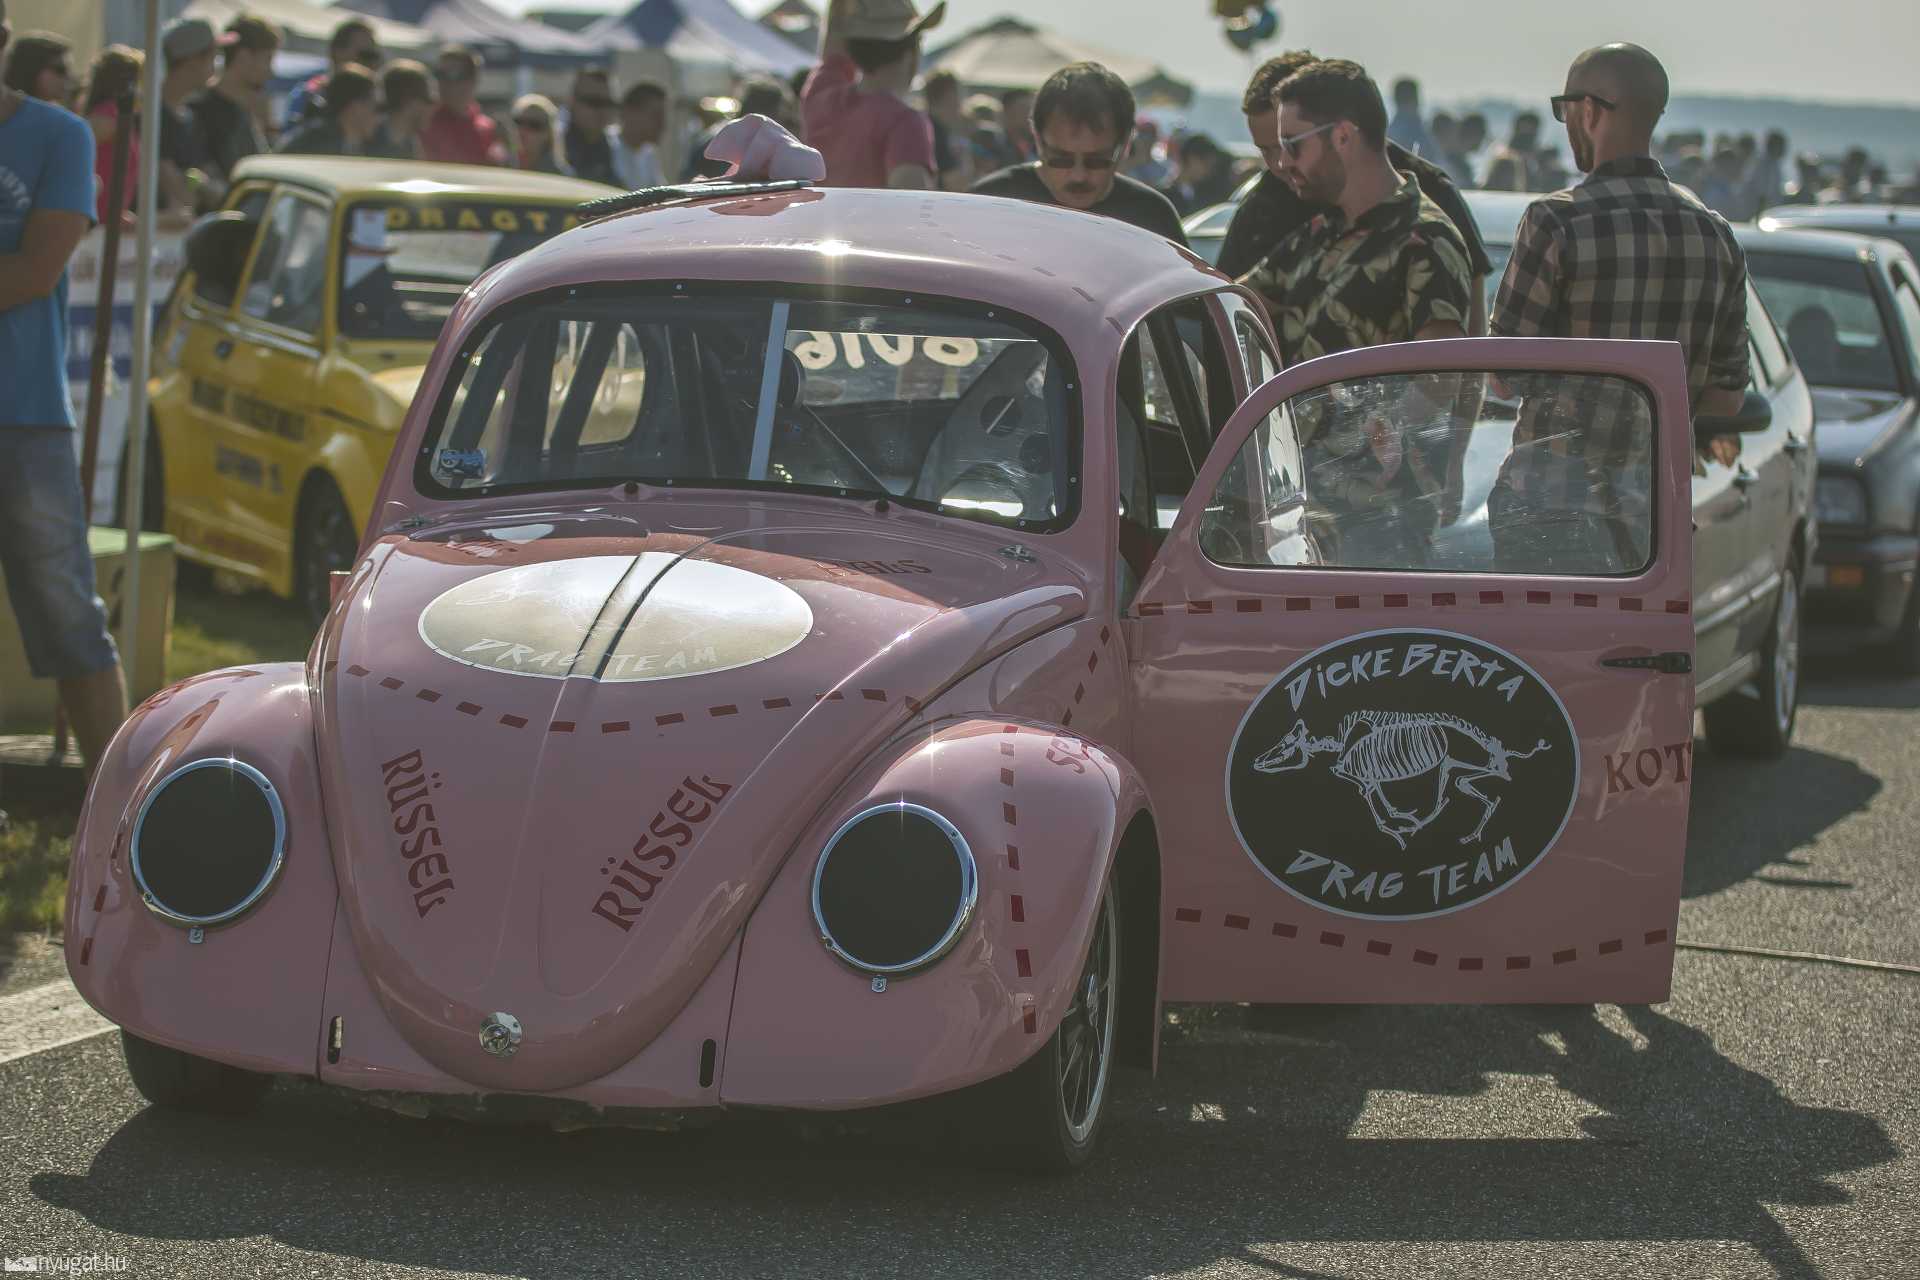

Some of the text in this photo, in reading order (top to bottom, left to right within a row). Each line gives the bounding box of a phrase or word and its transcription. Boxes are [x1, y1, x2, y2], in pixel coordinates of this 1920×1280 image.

[606, 645, 719, 676] TEAM
[1399, 643, 1524, 702] BERTA
[591, 774, 733, 932] RÜSSEL
[1285, 836, 1518, 905] DRAG TEAM
